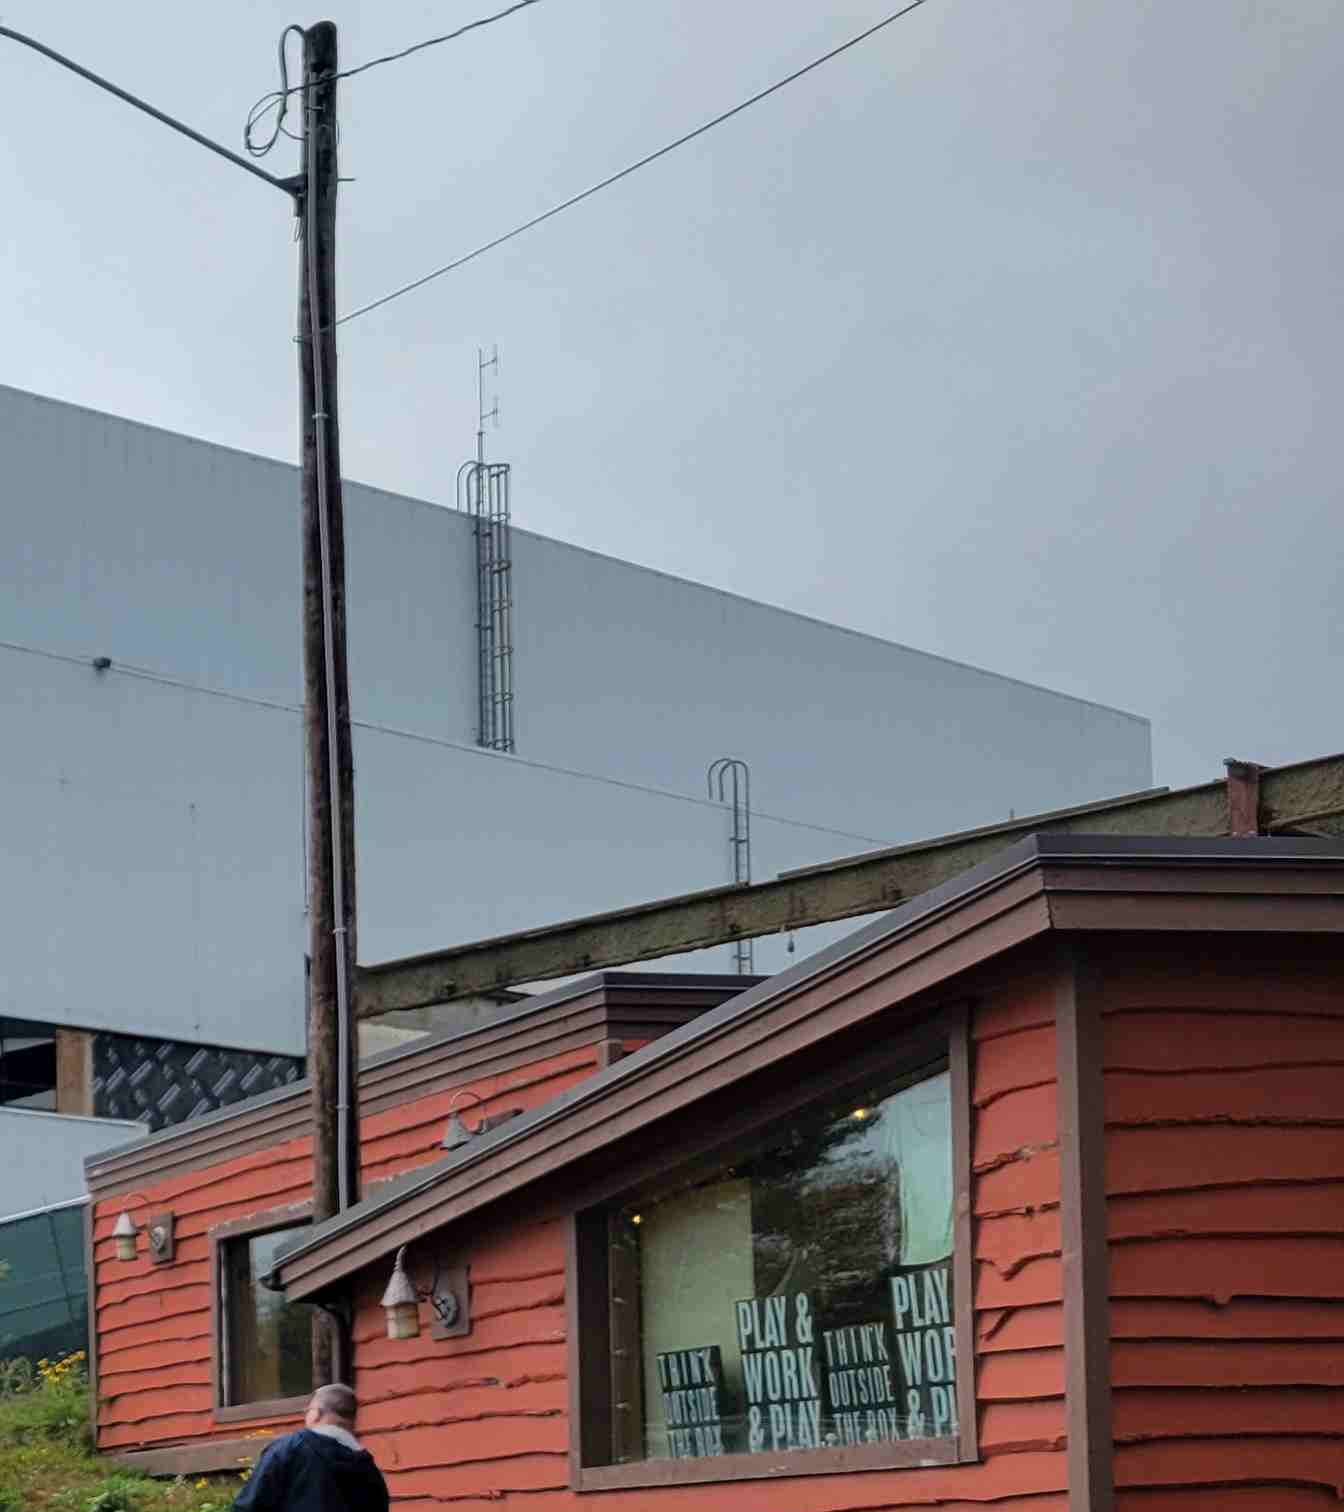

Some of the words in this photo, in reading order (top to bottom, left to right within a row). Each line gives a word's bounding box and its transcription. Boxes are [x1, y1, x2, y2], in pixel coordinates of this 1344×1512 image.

[738, 1295, 787, 1350] PLAY
[796, 1292, 813, 1343] &
[890, 1269, 950, 1329] PLAY
[822, 1322, 888, 1367] THINK
[897, 1327, 956, 1387] WOR
[742, 1347, 817, 1403] WORK
[828, 1365, 894, 1408] OUTSIDE
[749, 1405, 765, 1453] &
[769, 1400, 821, 1451] PLAY
[832, 1410, 862, 1446] THE
[907, 1388, 925, 1440] &
